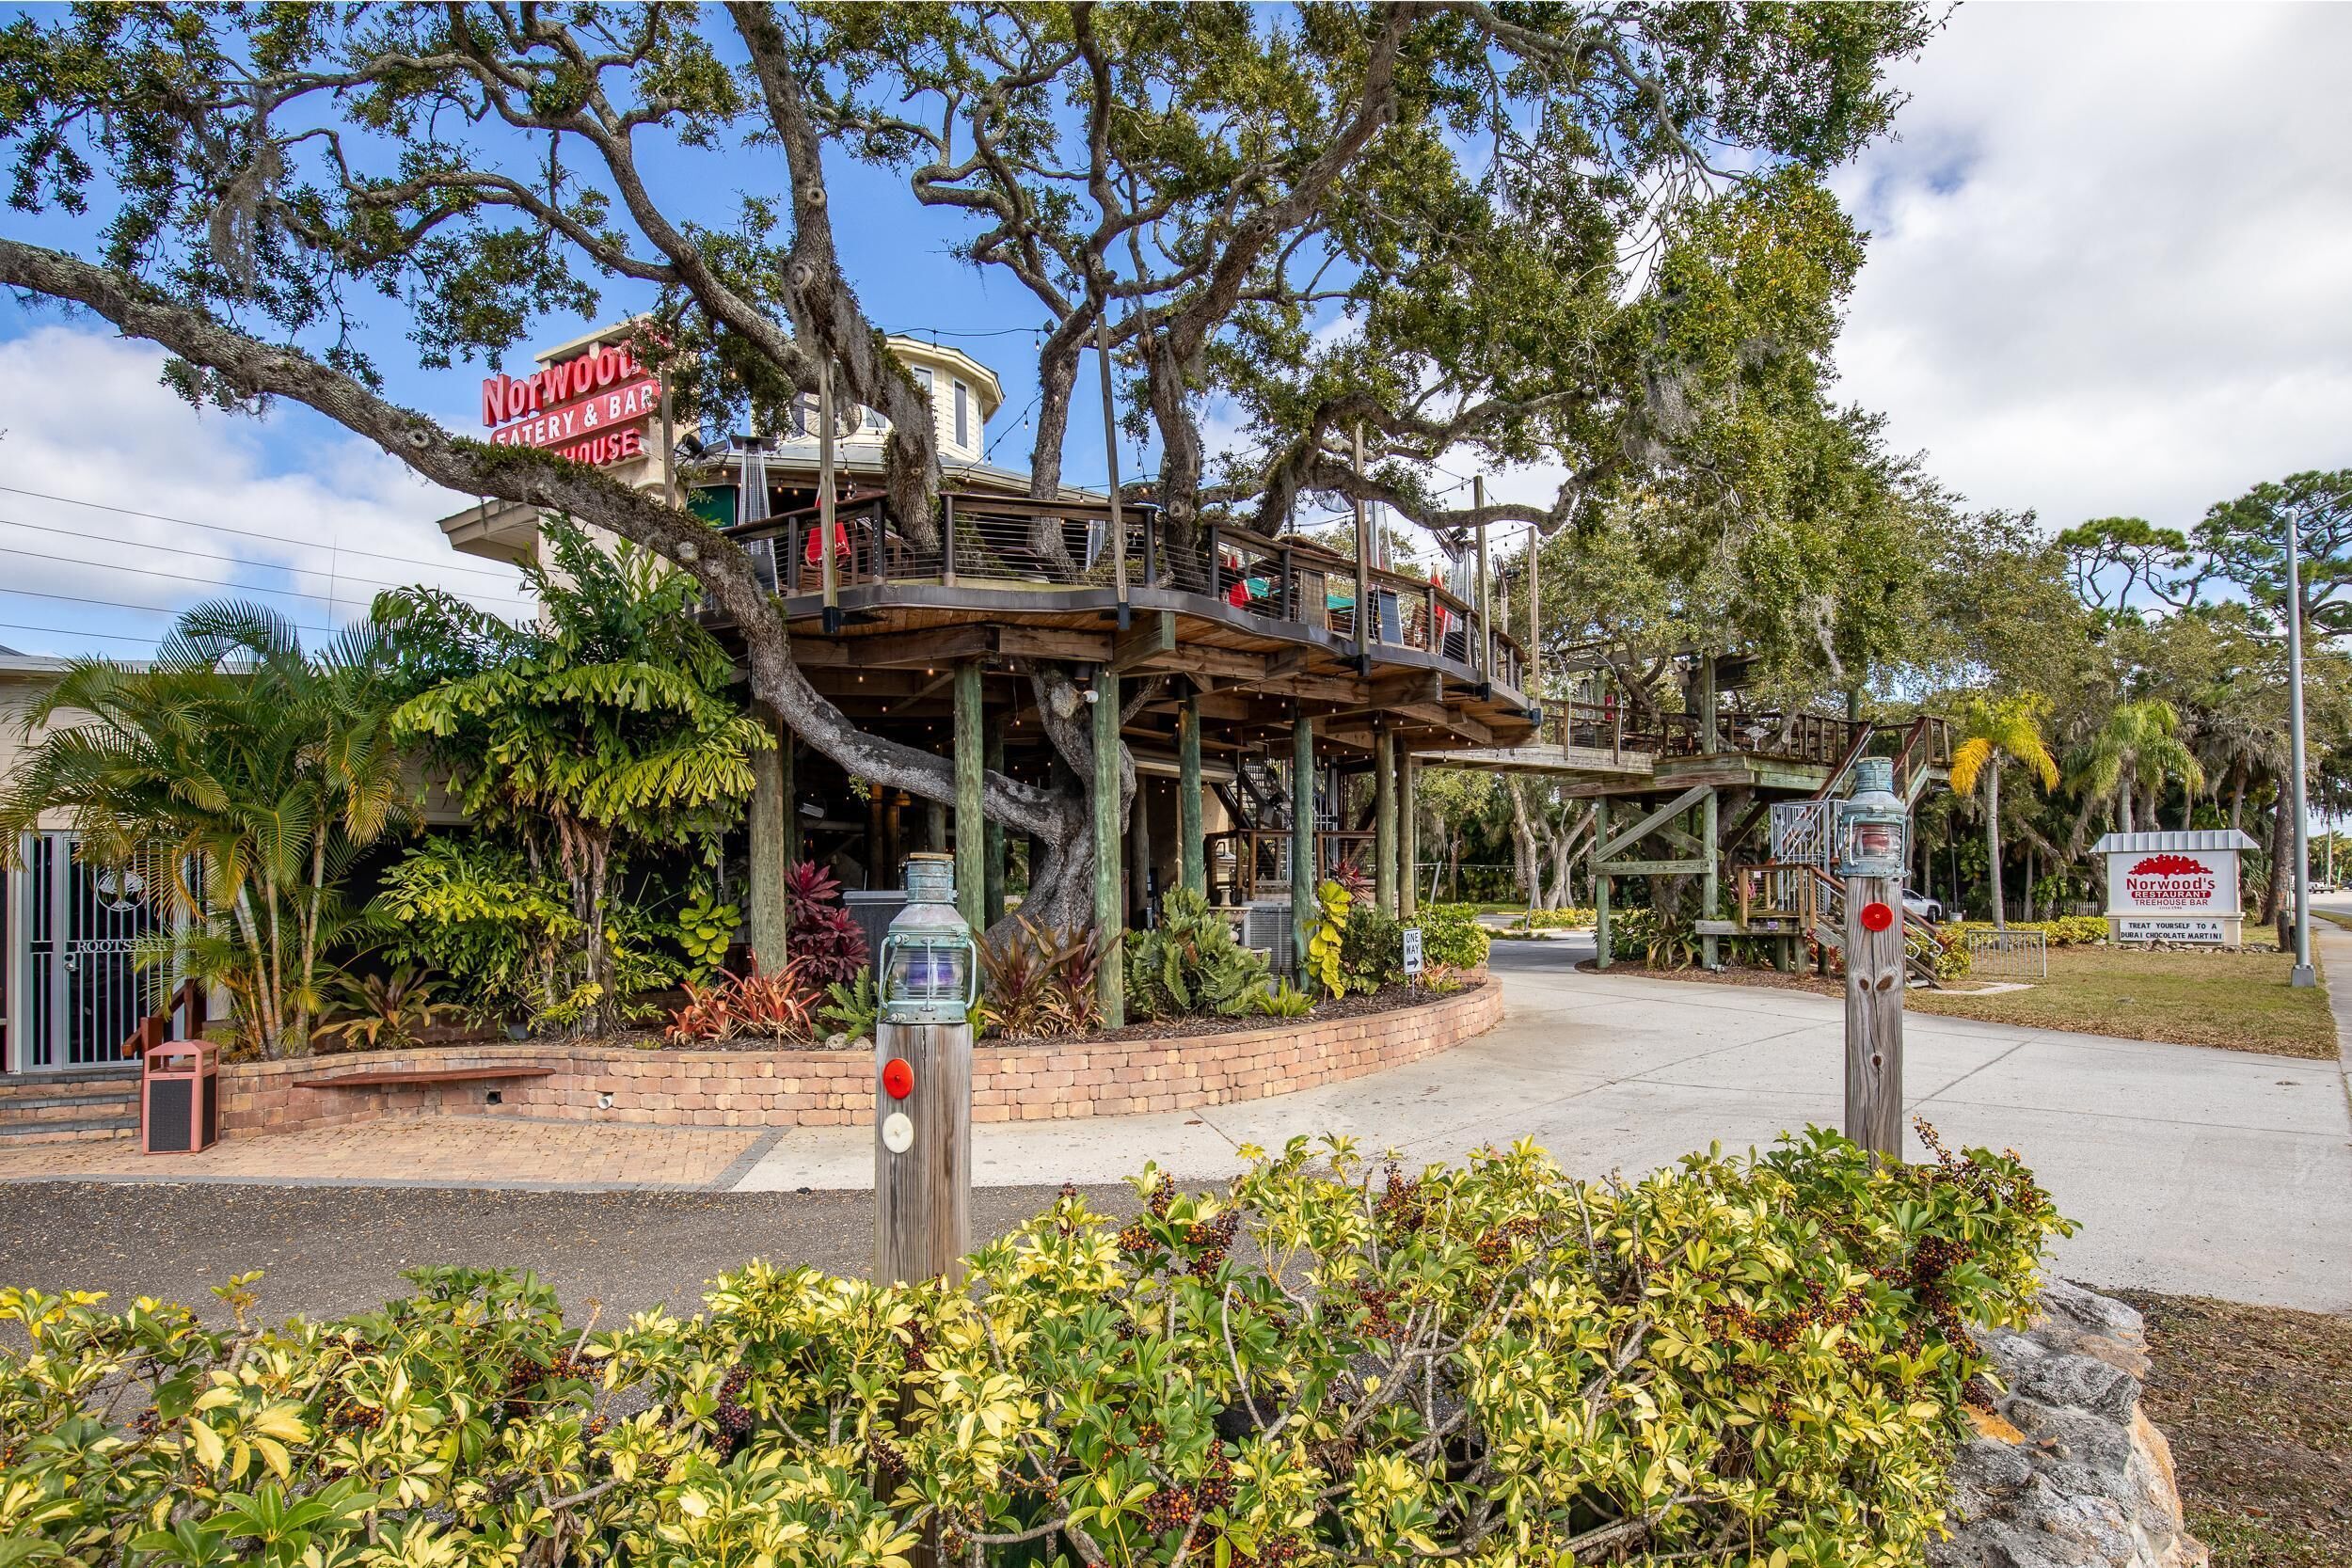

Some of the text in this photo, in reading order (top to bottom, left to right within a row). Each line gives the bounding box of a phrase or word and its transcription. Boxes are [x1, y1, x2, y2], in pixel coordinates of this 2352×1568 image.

[583, 403, 598, 428] &
[609, 384, 654, 420] BAR
[2126, 878, 2216, 890] Norwood's
[1406, 932, 1419, 943] ONE
[76, 941, 132, 953] ROOTS
[1406, 943, 1419, 955] WAY
